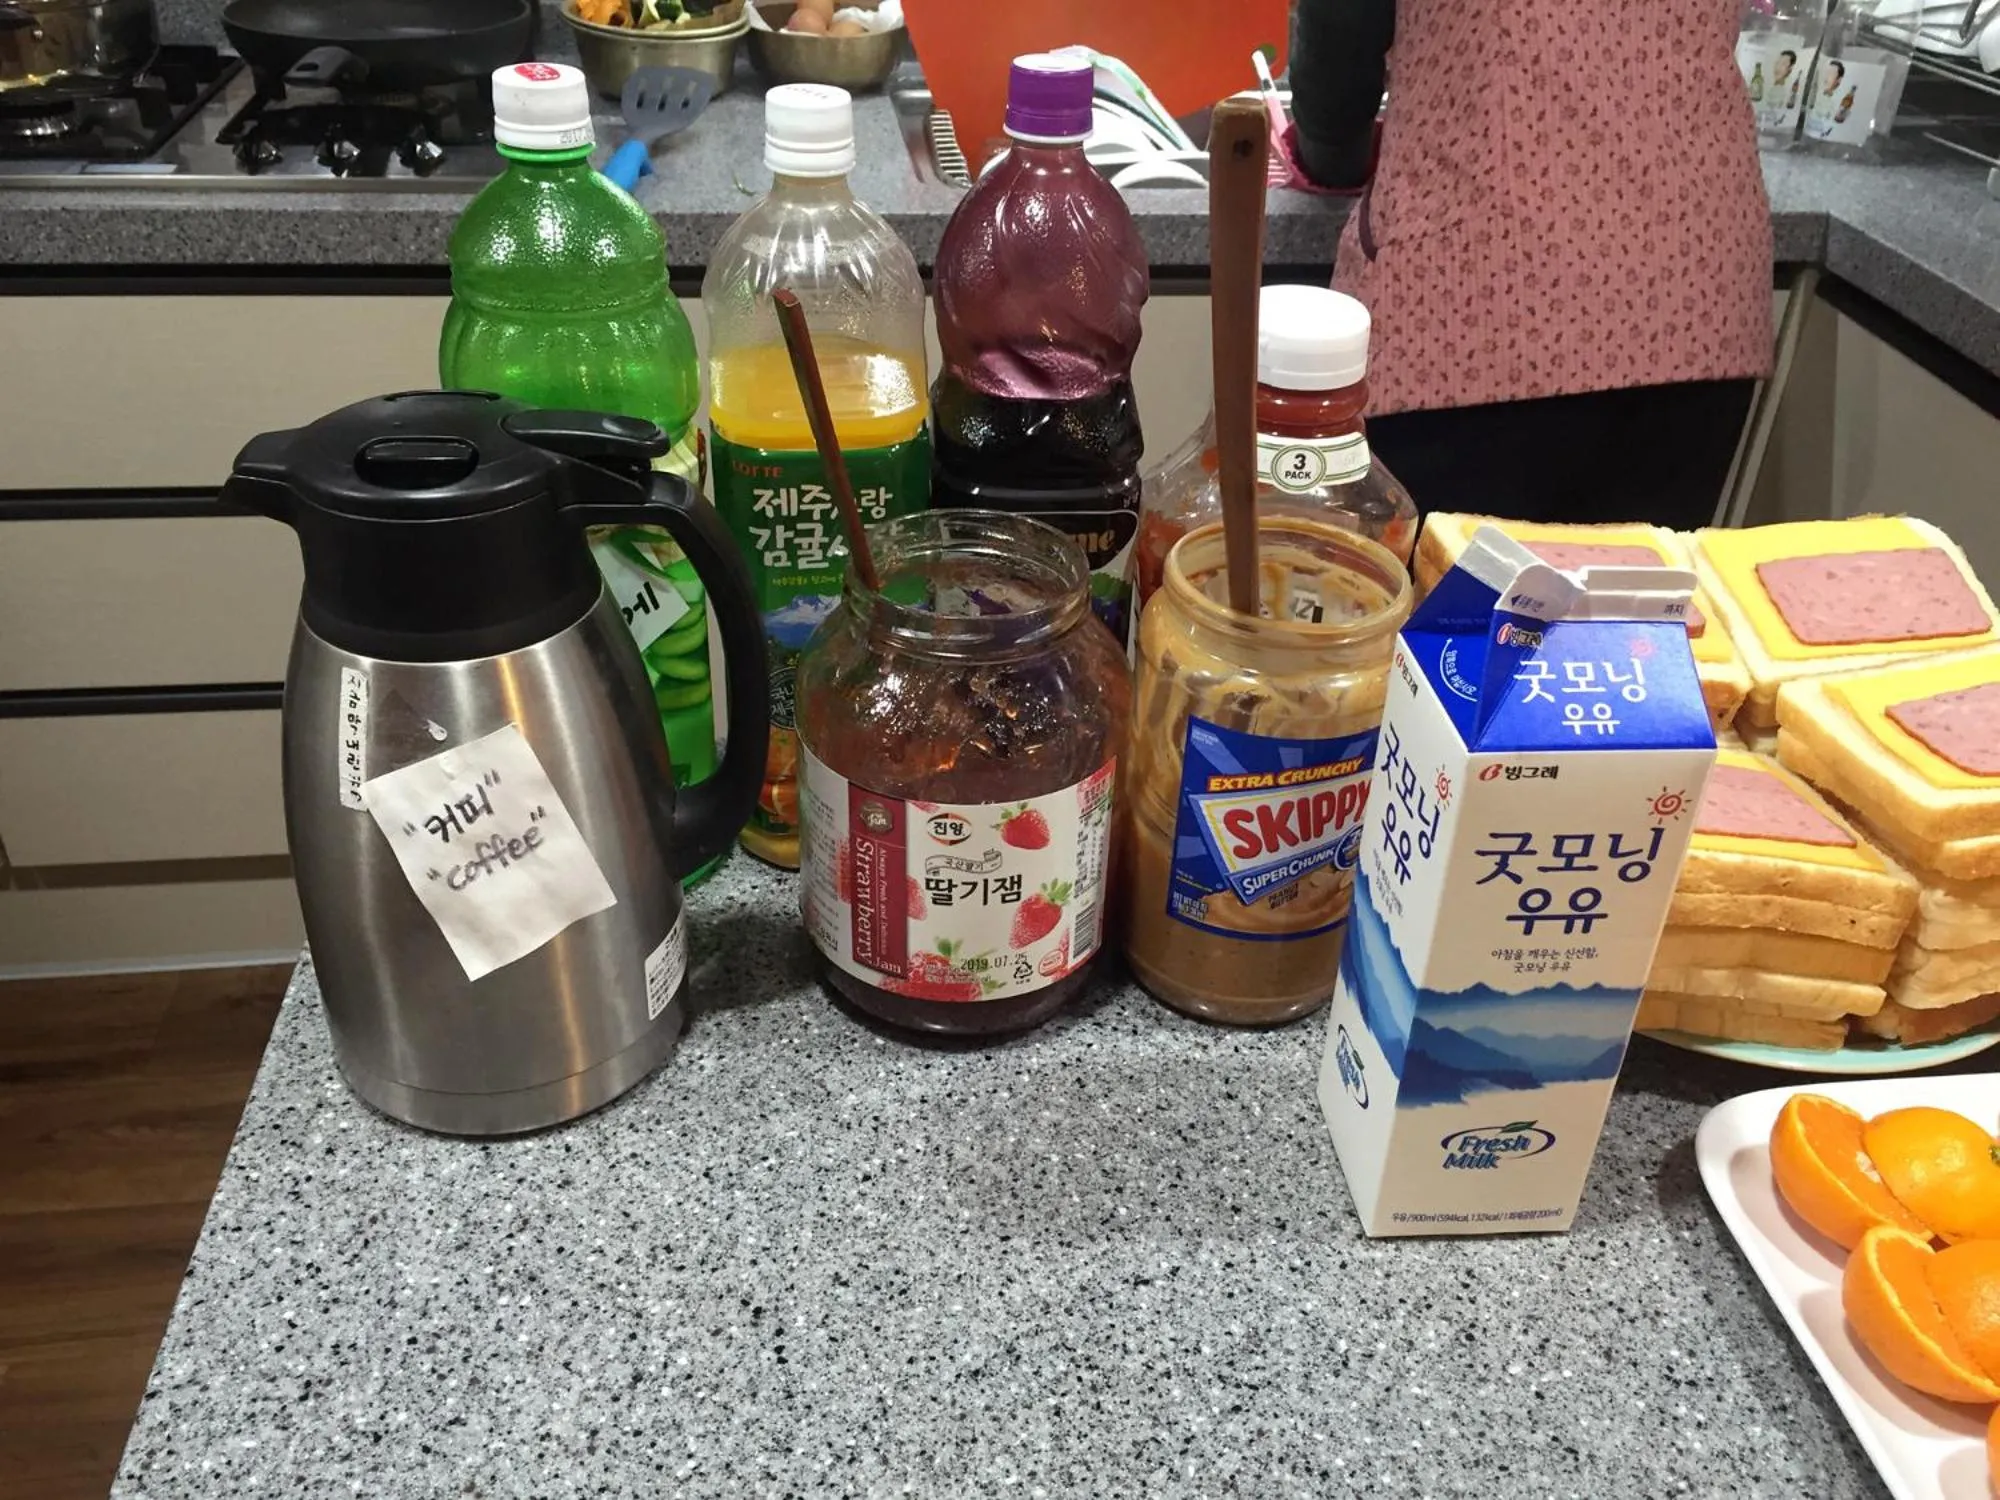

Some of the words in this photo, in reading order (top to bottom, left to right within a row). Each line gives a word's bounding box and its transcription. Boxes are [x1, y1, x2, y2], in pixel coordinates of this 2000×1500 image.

[732, 460, 783, 478] LOTTE
[1284, 470, 1312, 480] PACK
[1293, 453, 1307, 470] 3
[752, 484, 894, 520] 제주랑
[1513, 657, 1648, 703] 굿모닝
[1561, 703, 1621, 735] 우유
[1208, 773, 1275, 792] EXTRA
[1279, 757, 1365, 786] CRUNCHY
[1381, 721, 1440, 859] 굿모닝
[1504, 765, 1559, 780] 빙그레
[1223, 779, 1371, 860] SKIPPY
[1382, 802, 1411, 885] 우유
[1474, 827, 1665, 885] 굿모닝
[855, 838, 875, 963] Strawberry
[924, 874, 1023, 906] 딸기잼
[1505, 887, 1608, 936] 우유
[1442, 1152, 1501, 1169] Milk
[1457, 1134, 1531, 1155] Fresh
